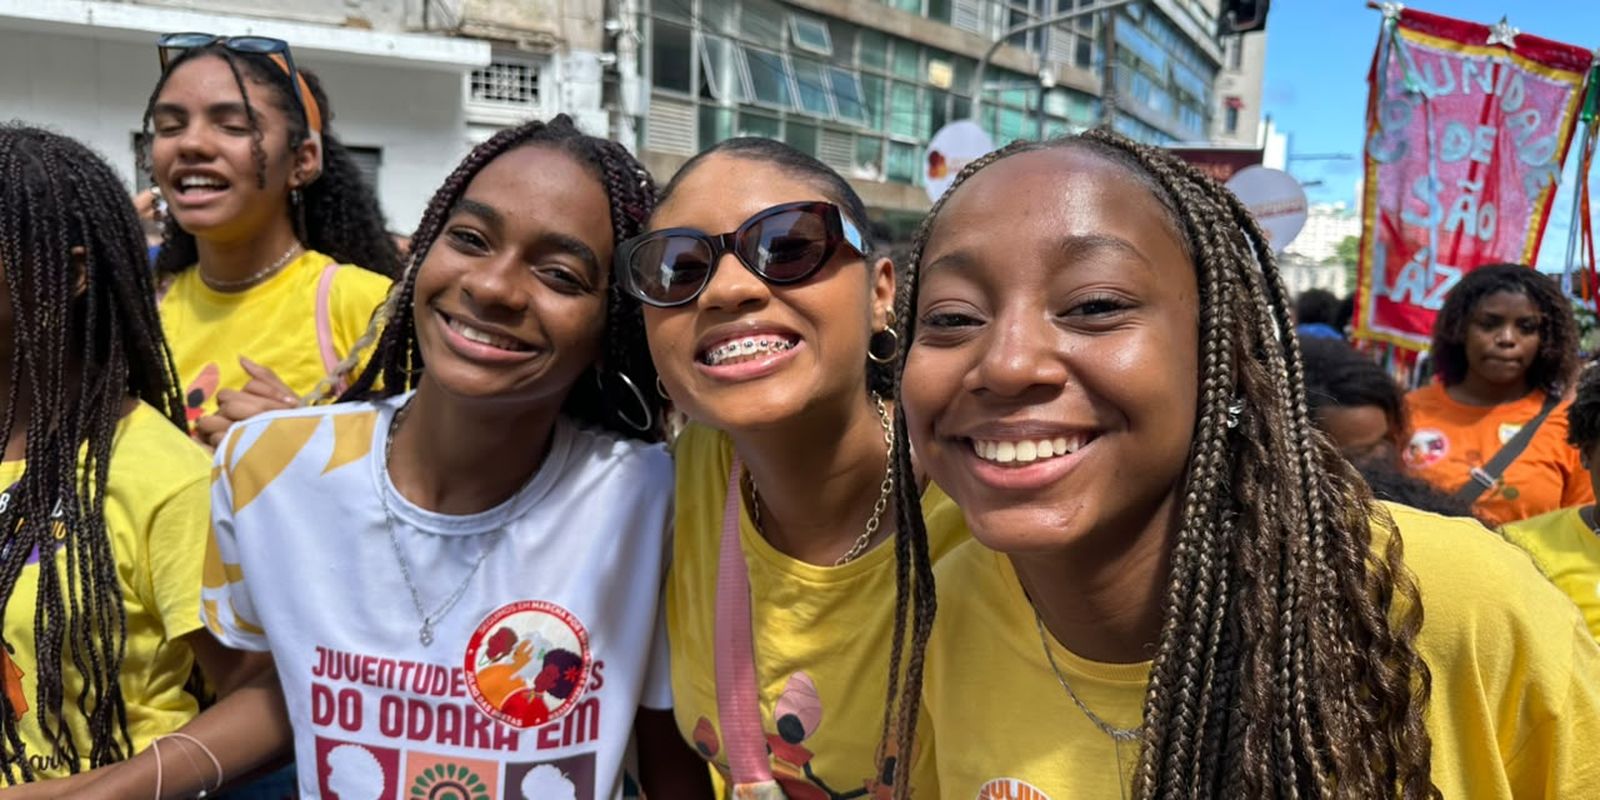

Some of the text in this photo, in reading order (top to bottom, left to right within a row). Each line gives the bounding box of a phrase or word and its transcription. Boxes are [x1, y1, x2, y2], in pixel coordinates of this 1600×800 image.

[1368, 55, 1562, 203] COUNIDADE
[1440, 121, 1497, 164] DE
[1401, 174, 1496, 241] SÃO
[1373, 246, 1463, 311] LÁZ
[531, 600, 567, 618] MARCHA
[311, 682, 600, 752] DO ODARA EM
